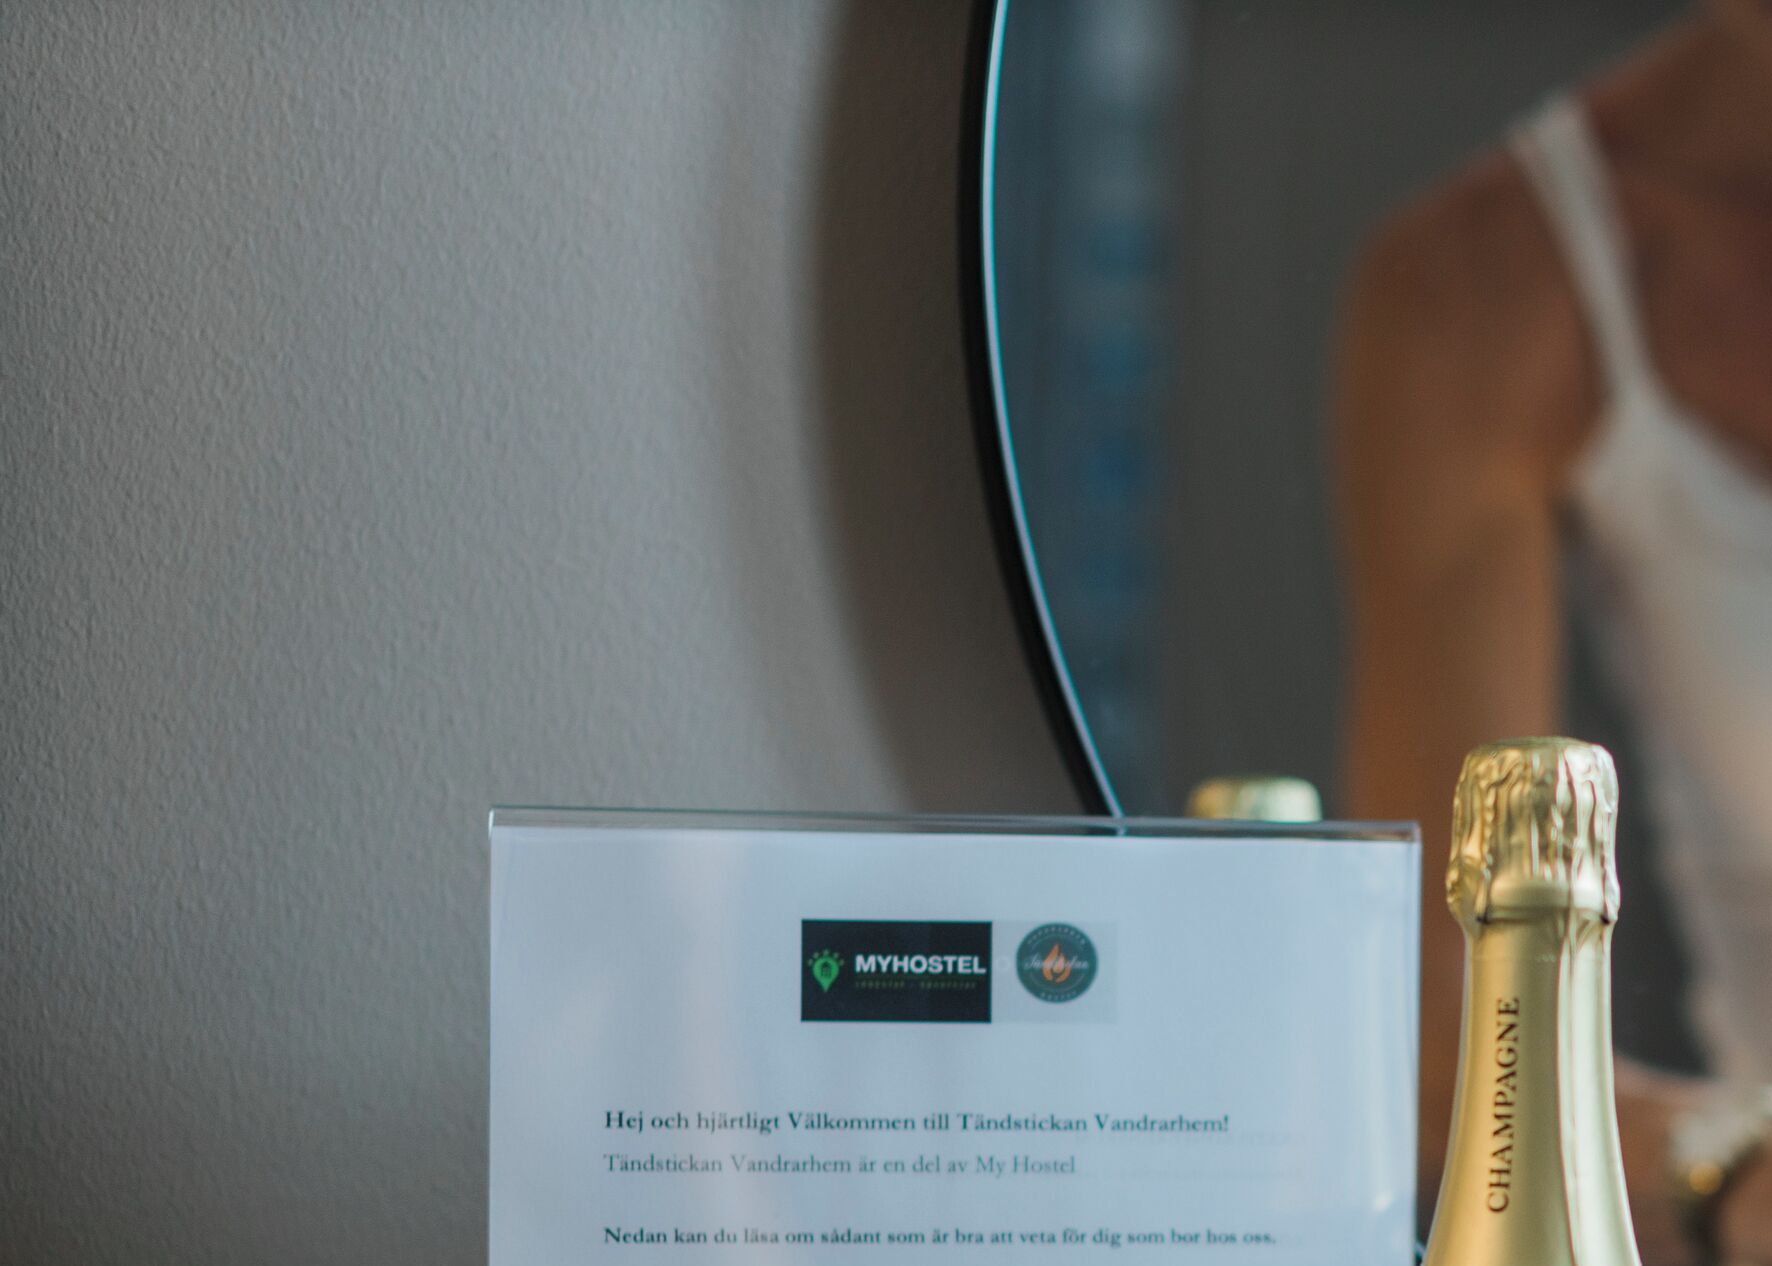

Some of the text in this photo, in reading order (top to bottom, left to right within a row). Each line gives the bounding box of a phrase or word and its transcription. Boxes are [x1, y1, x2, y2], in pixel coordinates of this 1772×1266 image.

[855, 954, 986, 974] MYHOSTEL
[1486, 997, 1521, 1214] CHAMPAGNE
[604, 1112, 1229, 1135] Hej och hjärtligt Välkommen till Tändstickan Vandrarhem!
[604, 1154, 1075, 1178] Tändstickan Vandrarhem är en del av My Hostel
[604, 1228, 1276, 1248] Nedan kan du läsa om sådant som är bra att veta för dig som bor hos oss.
